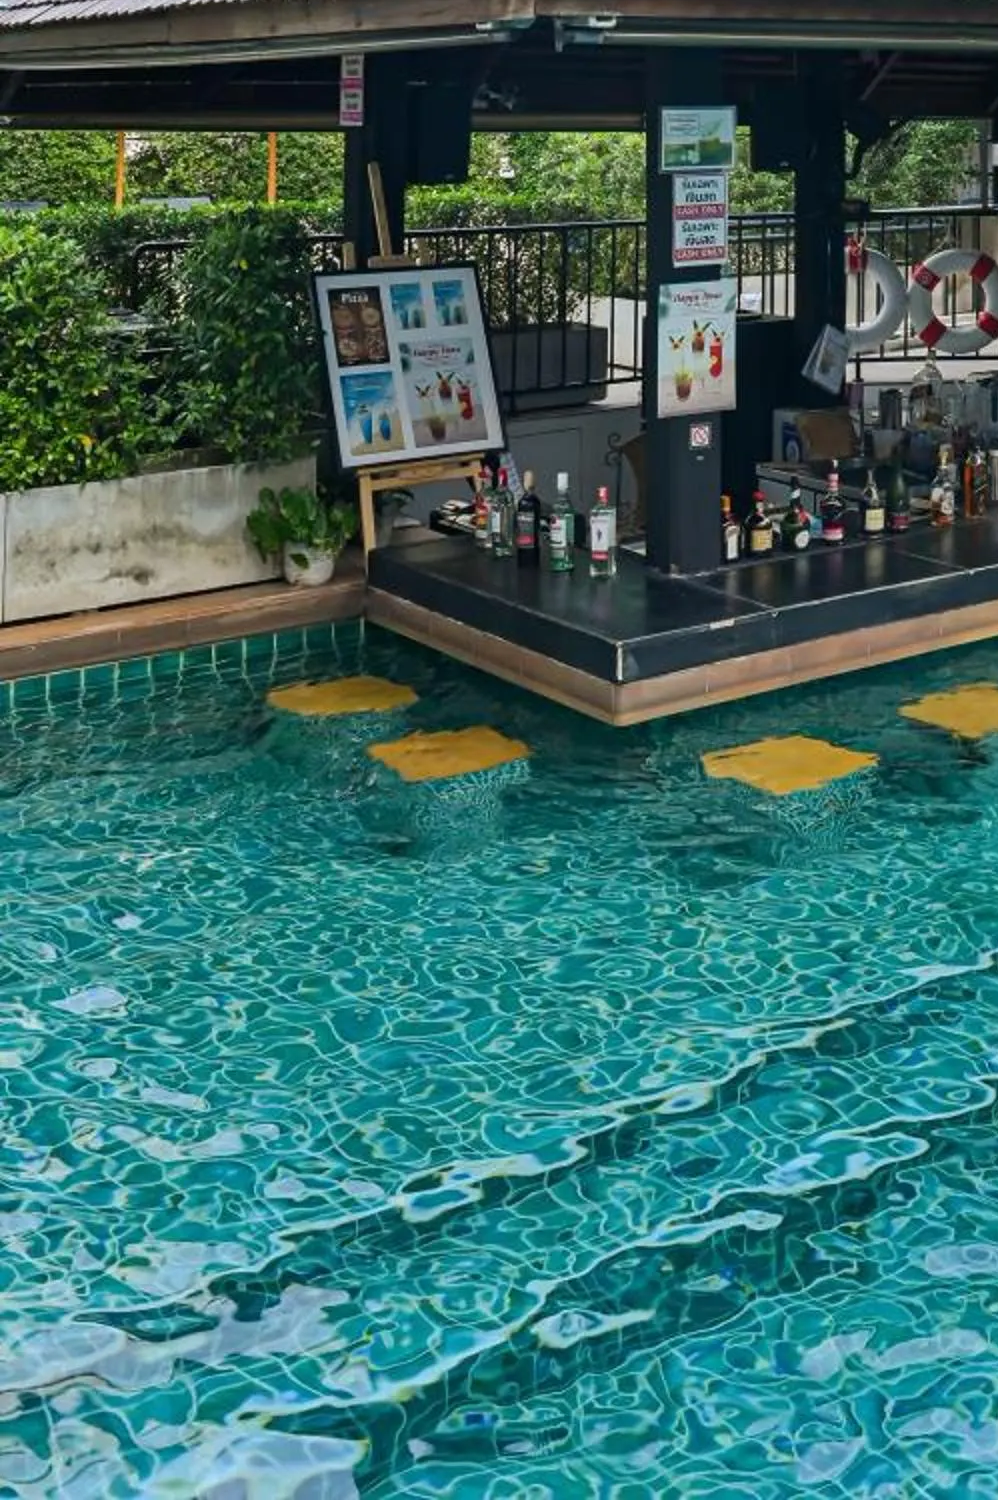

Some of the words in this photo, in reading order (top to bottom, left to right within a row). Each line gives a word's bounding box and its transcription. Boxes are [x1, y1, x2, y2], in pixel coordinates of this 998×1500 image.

[676, 206, 698, 216] CASH
[701, 204, 724, 214] ONLY
[676, 250, 699, 260] CASH
[701, 247, 724, 258] ONLY
[341, 292, 369, 304] Pizza
